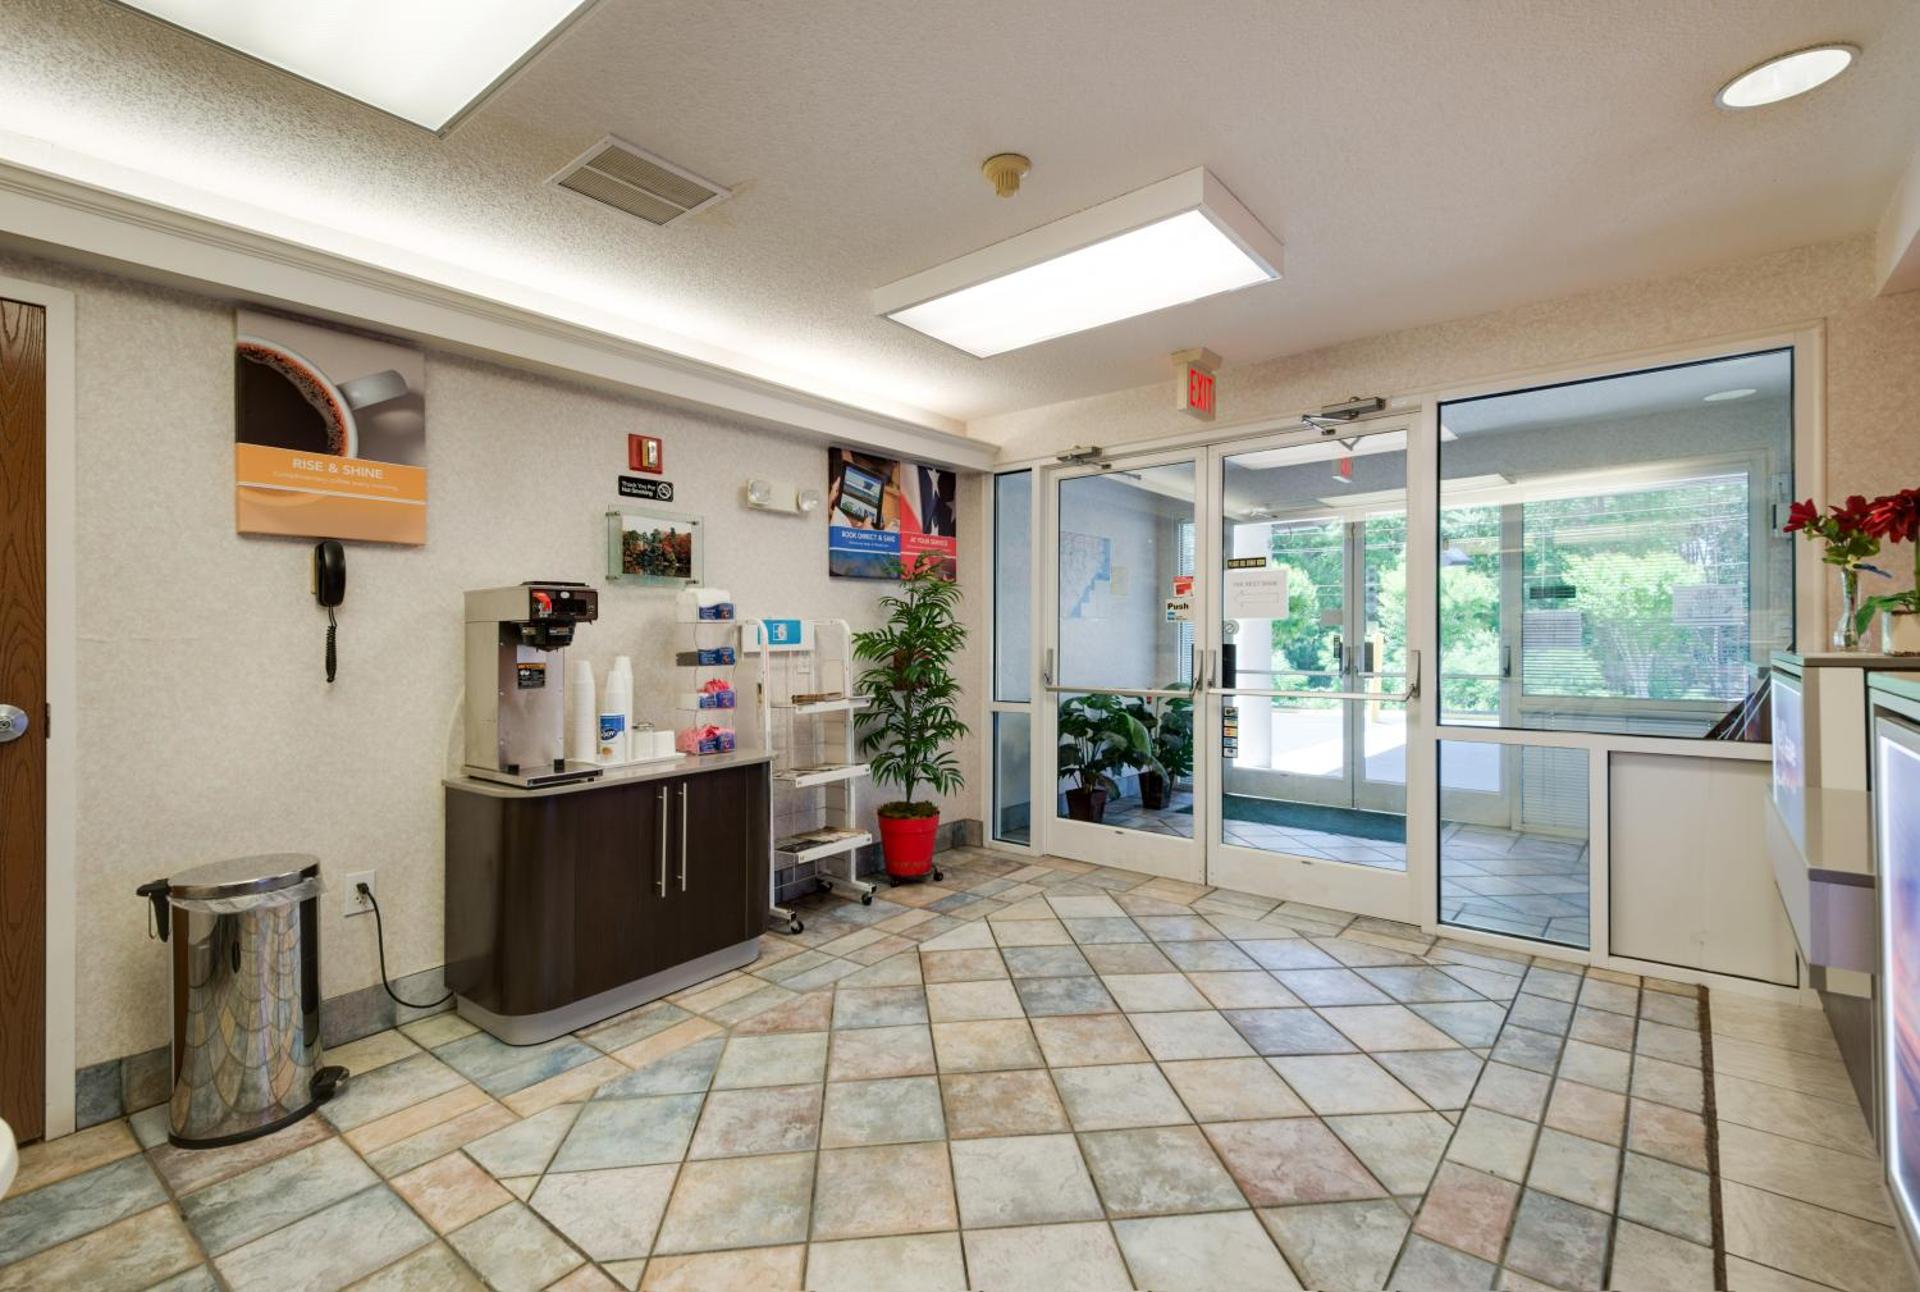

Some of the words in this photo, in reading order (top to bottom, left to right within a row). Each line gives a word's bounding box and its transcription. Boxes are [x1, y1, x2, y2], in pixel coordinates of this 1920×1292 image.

[1189, 368, 1213, 415] EXIT
[292, 458, 324, 472] RISE
[328, 463, 338, 473] &
[343, 465, 383, 479] SHINE
[637, 482, 646, 490] You
[632, 488, 653, 497] Smoking
[842, 530, 858, 539] BOOK
[858, 532, 877, 540] DIRECT
[883, 535, 896, 543] SAVE
[1167, 602, 1189, 610] Push
